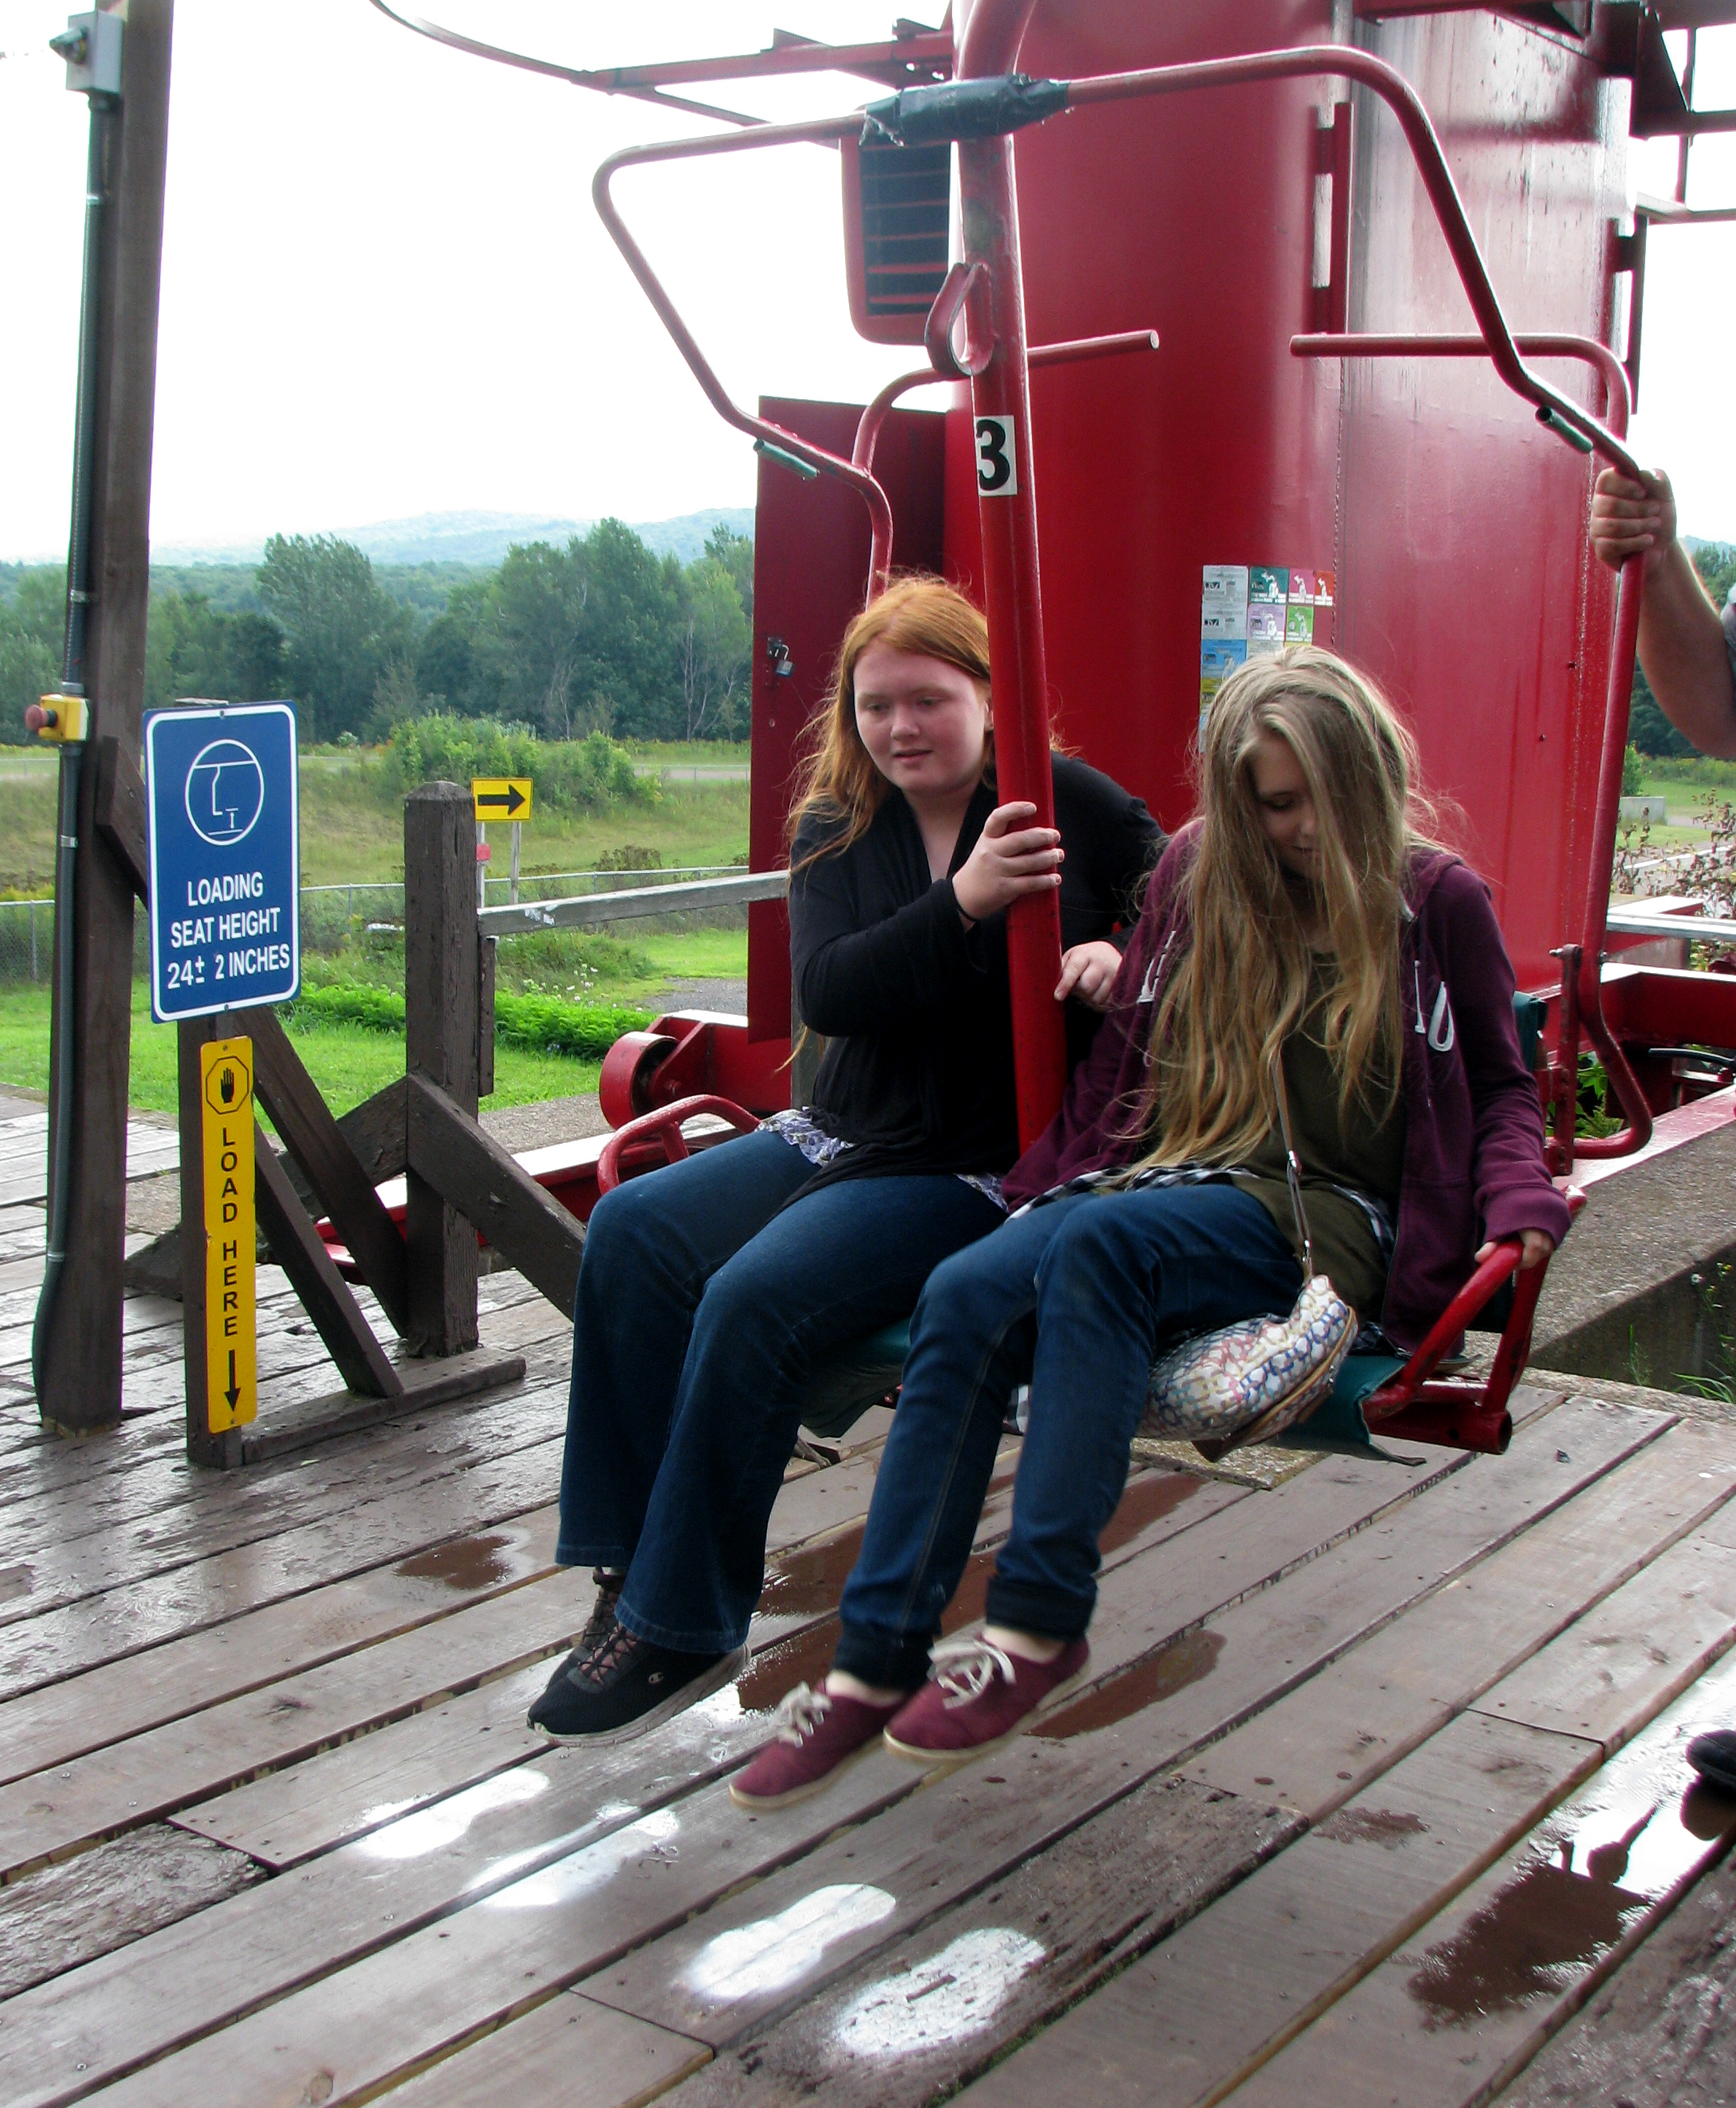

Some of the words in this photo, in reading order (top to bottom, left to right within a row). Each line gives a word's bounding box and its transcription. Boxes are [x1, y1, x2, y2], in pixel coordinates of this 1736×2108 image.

[976, 419, 1010, 491] 3
[188, 871, 263, 906] LOADING
[171, 916, 215, 948] SEAT
[219, 907, 281, 941] HEIGHT
[215, 954, 225, 980] 2
[229, 943, 290, 977] INCHES
[221, 1127, 238, 1223] LOAD
[222, 1239, 238, 1337] HERE
